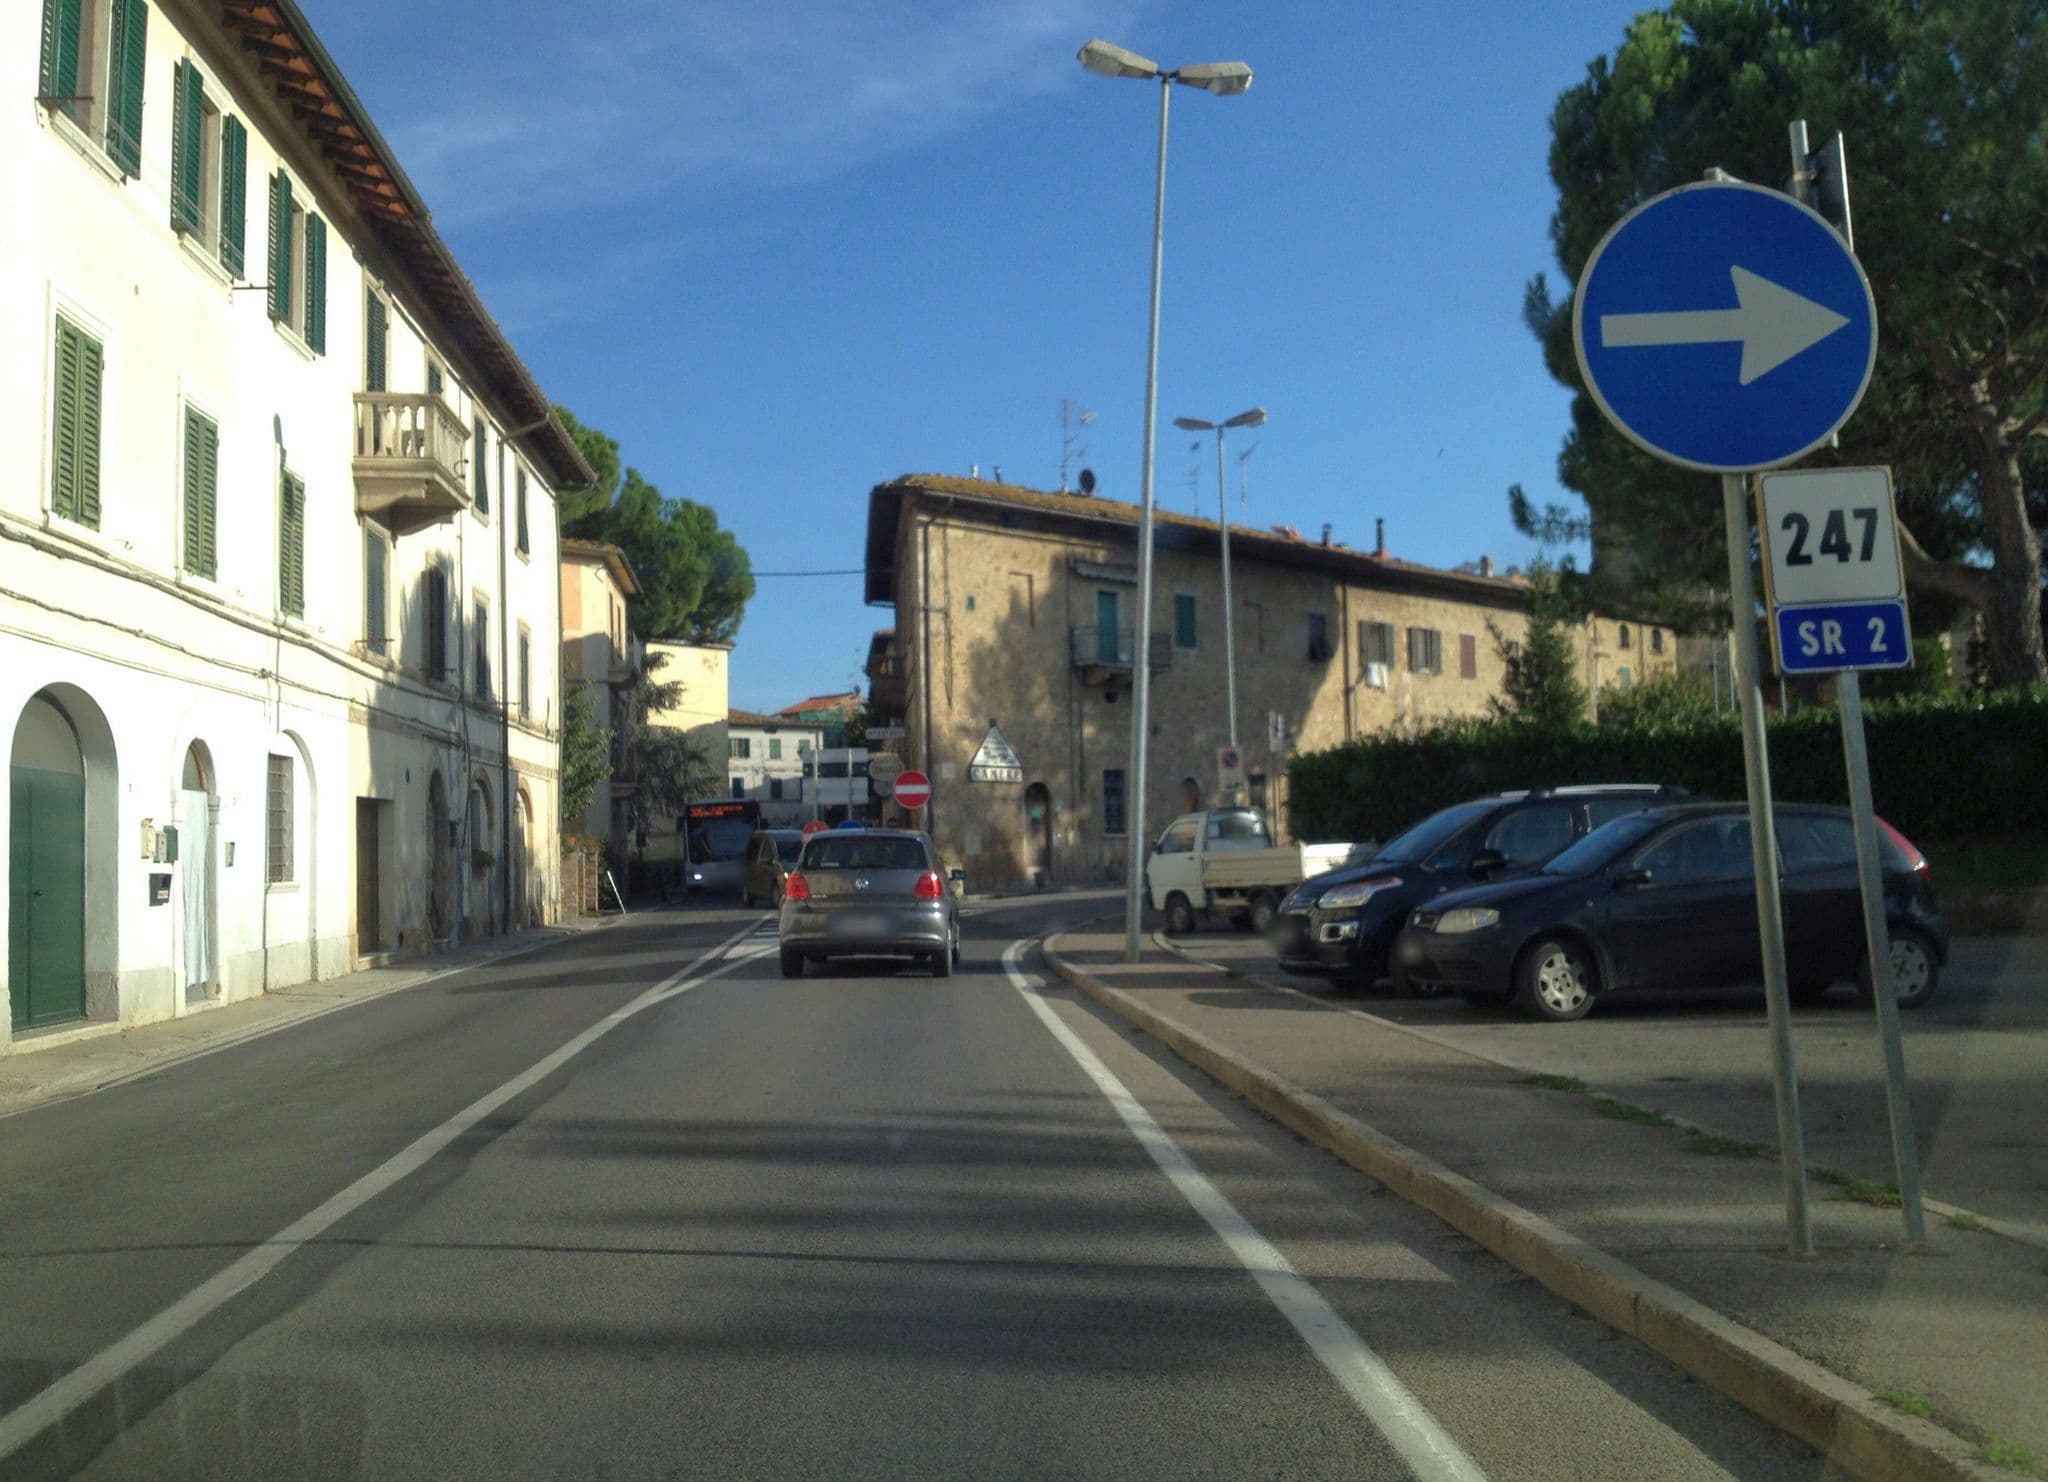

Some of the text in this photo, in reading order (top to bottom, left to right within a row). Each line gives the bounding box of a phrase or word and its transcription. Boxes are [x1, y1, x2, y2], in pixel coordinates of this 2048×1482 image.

[1781, 508, 1878, 566] 247
[1799, 617, 1887, 656] SR 2
